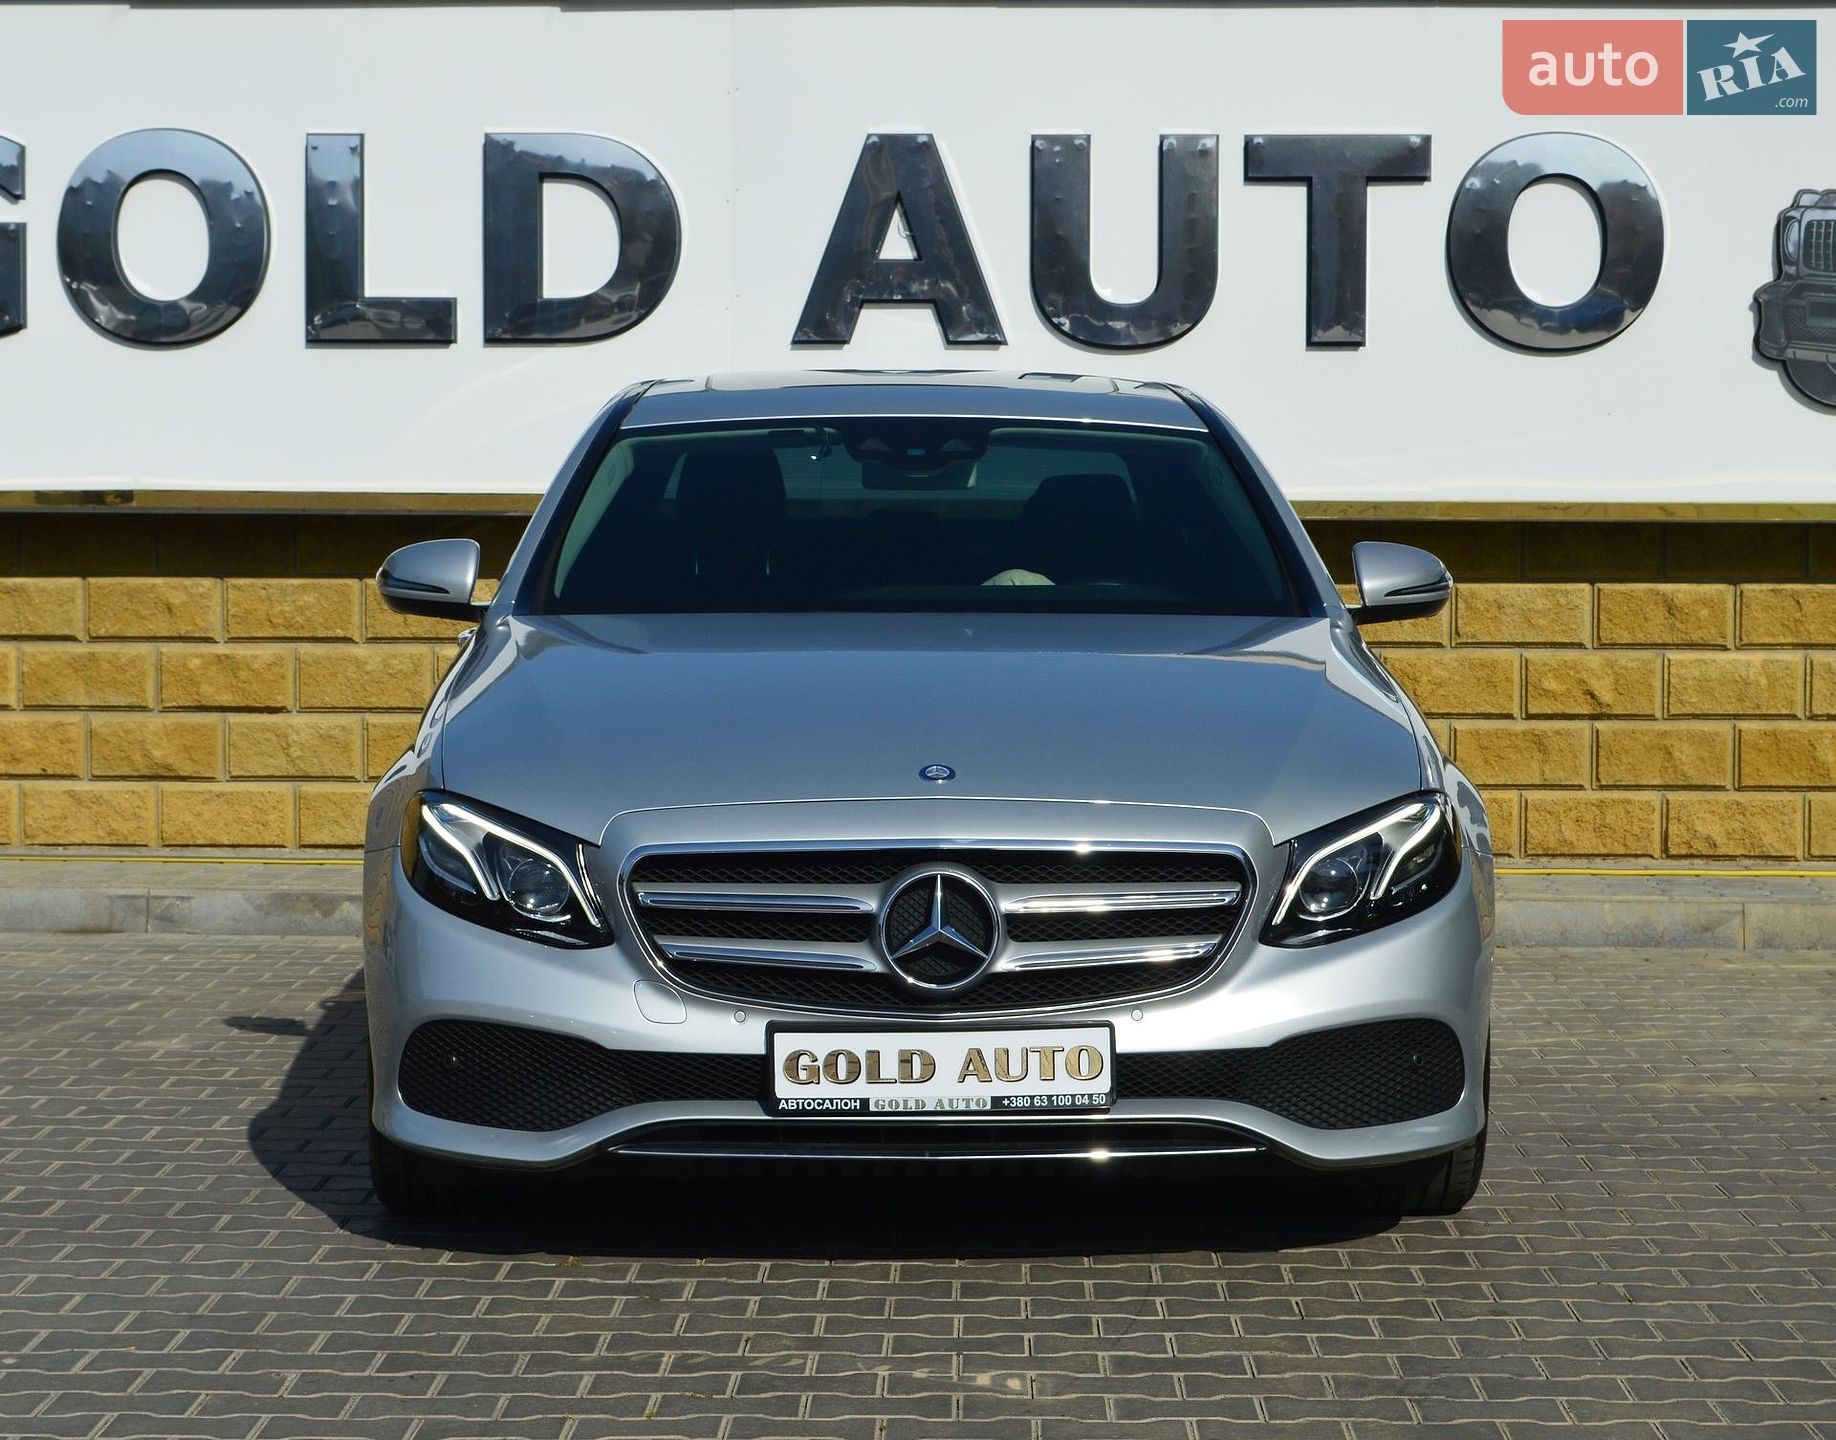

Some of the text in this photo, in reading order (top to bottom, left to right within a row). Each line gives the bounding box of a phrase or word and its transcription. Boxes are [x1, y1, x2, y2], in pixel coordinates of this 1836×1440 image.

[0, 128, 1665, 351] OLD AUTO
[783, 1045, 1105, 1084] GOLD AUTO
[778, 1099, 860, 1110] АВТОСАЛОН
[873, 1097, 988, 1111] GOLD AUTO
[1002, 1094, 1106, 1107] +380 63 100 04 50
